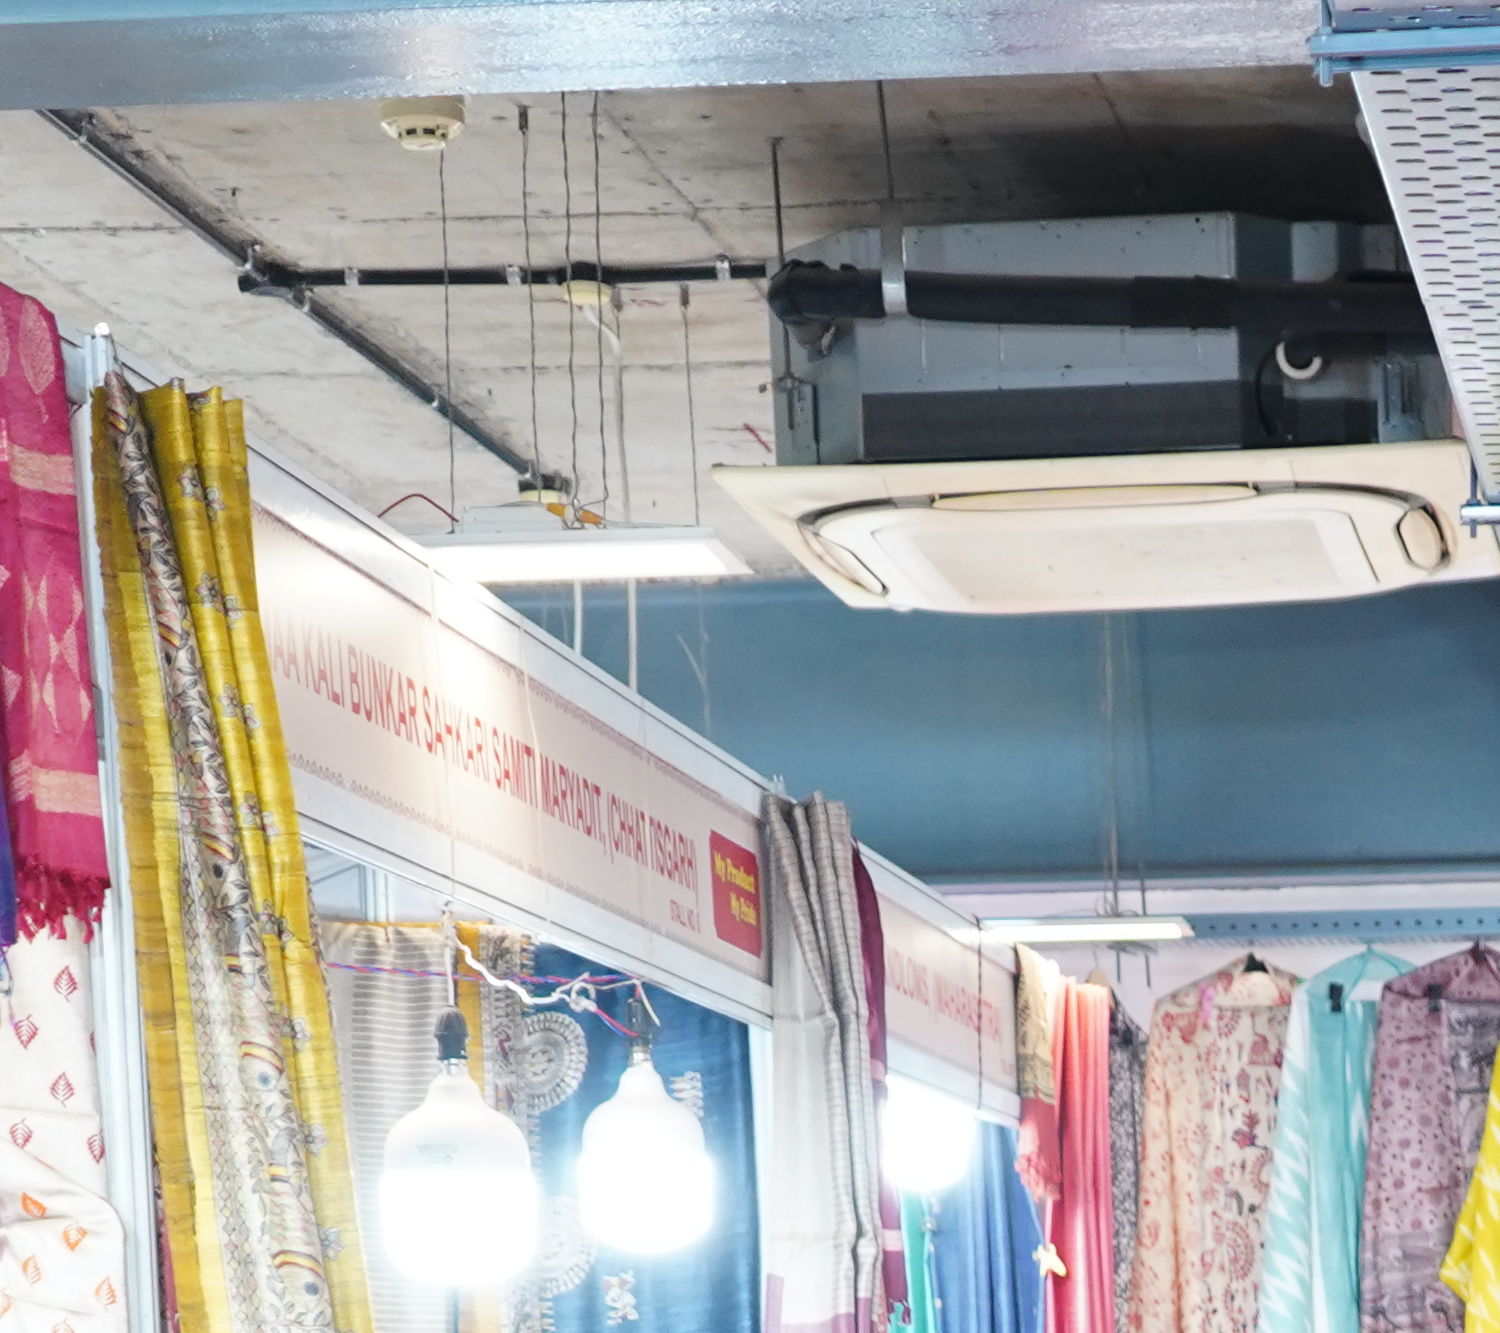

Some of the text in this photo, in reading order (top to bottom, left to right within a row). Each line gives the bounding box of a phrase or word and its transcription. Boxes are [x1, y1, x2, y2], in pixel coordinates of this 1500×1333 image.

[264, 602, 301, 685] AA
[302, 620, 345, 708] KALI
[348, 642, 421, 748] BUNKAR
[423, 686, 490, 784] SAHKARI
[492, 725, 538, 810] SAMITI
[713, 850, 756, 894] My Product
[730, 891, 740, 922] My
